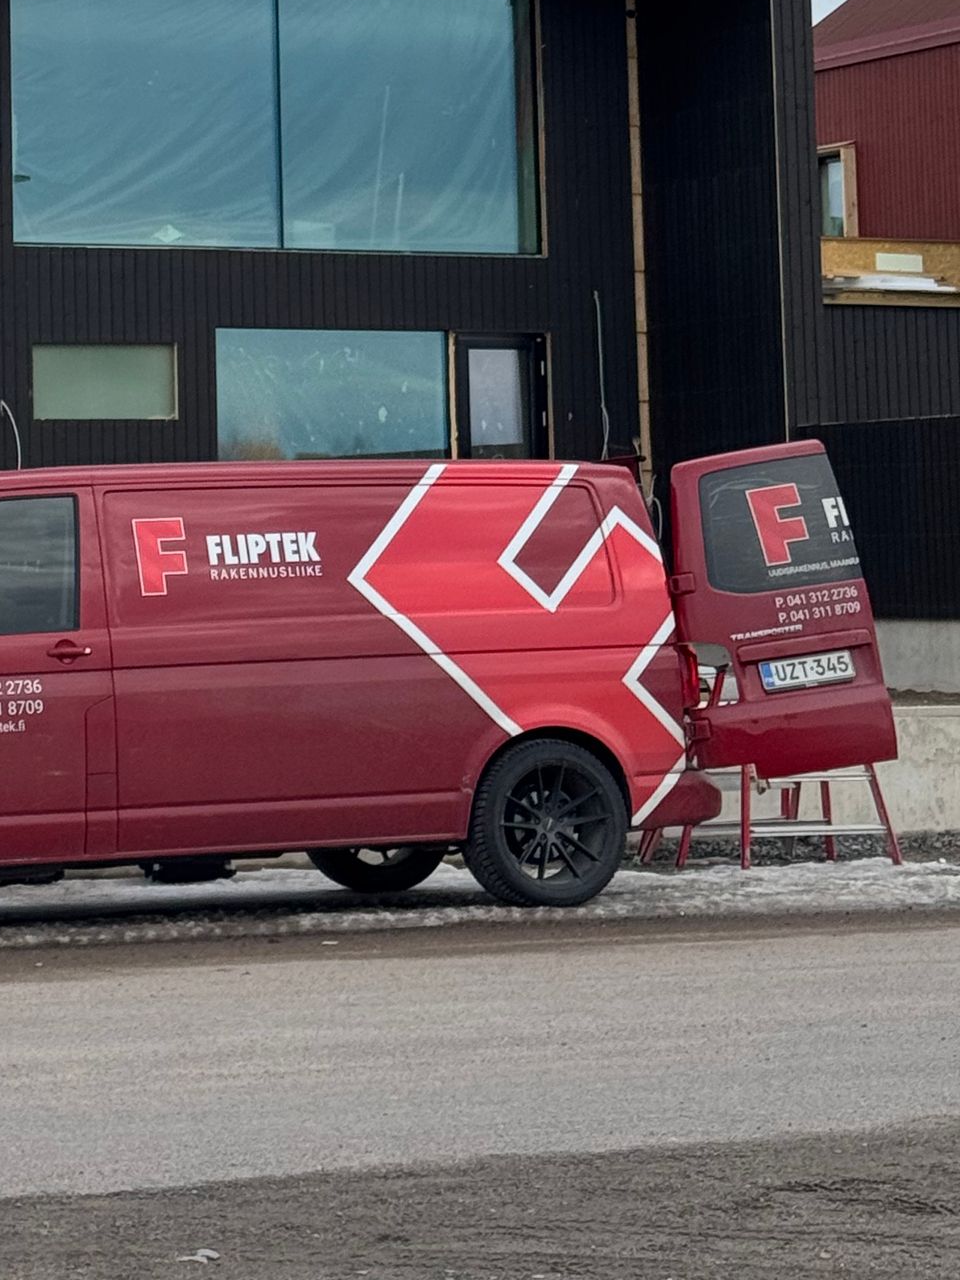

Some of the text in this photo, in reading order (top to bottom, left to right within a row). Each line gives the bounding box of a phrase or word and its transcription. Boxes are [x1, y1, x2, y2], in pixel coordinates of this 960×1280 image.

[745, 482, 809, 566] F
[132, 517, 188, 596] F
[206, 531, 321, 565] FLIPTEK
[210, 565, 323, 580] RAKENNUSLIIKE
[775, 585, 858, 608] P. 041 312 2736
[778, 601, 861, 623] P. 041 311 8709
[730, 624, 802, 640] TRANSPORTER
[6, 679, 42, 695] 2736
[8, 699, 44, 715] 8709
